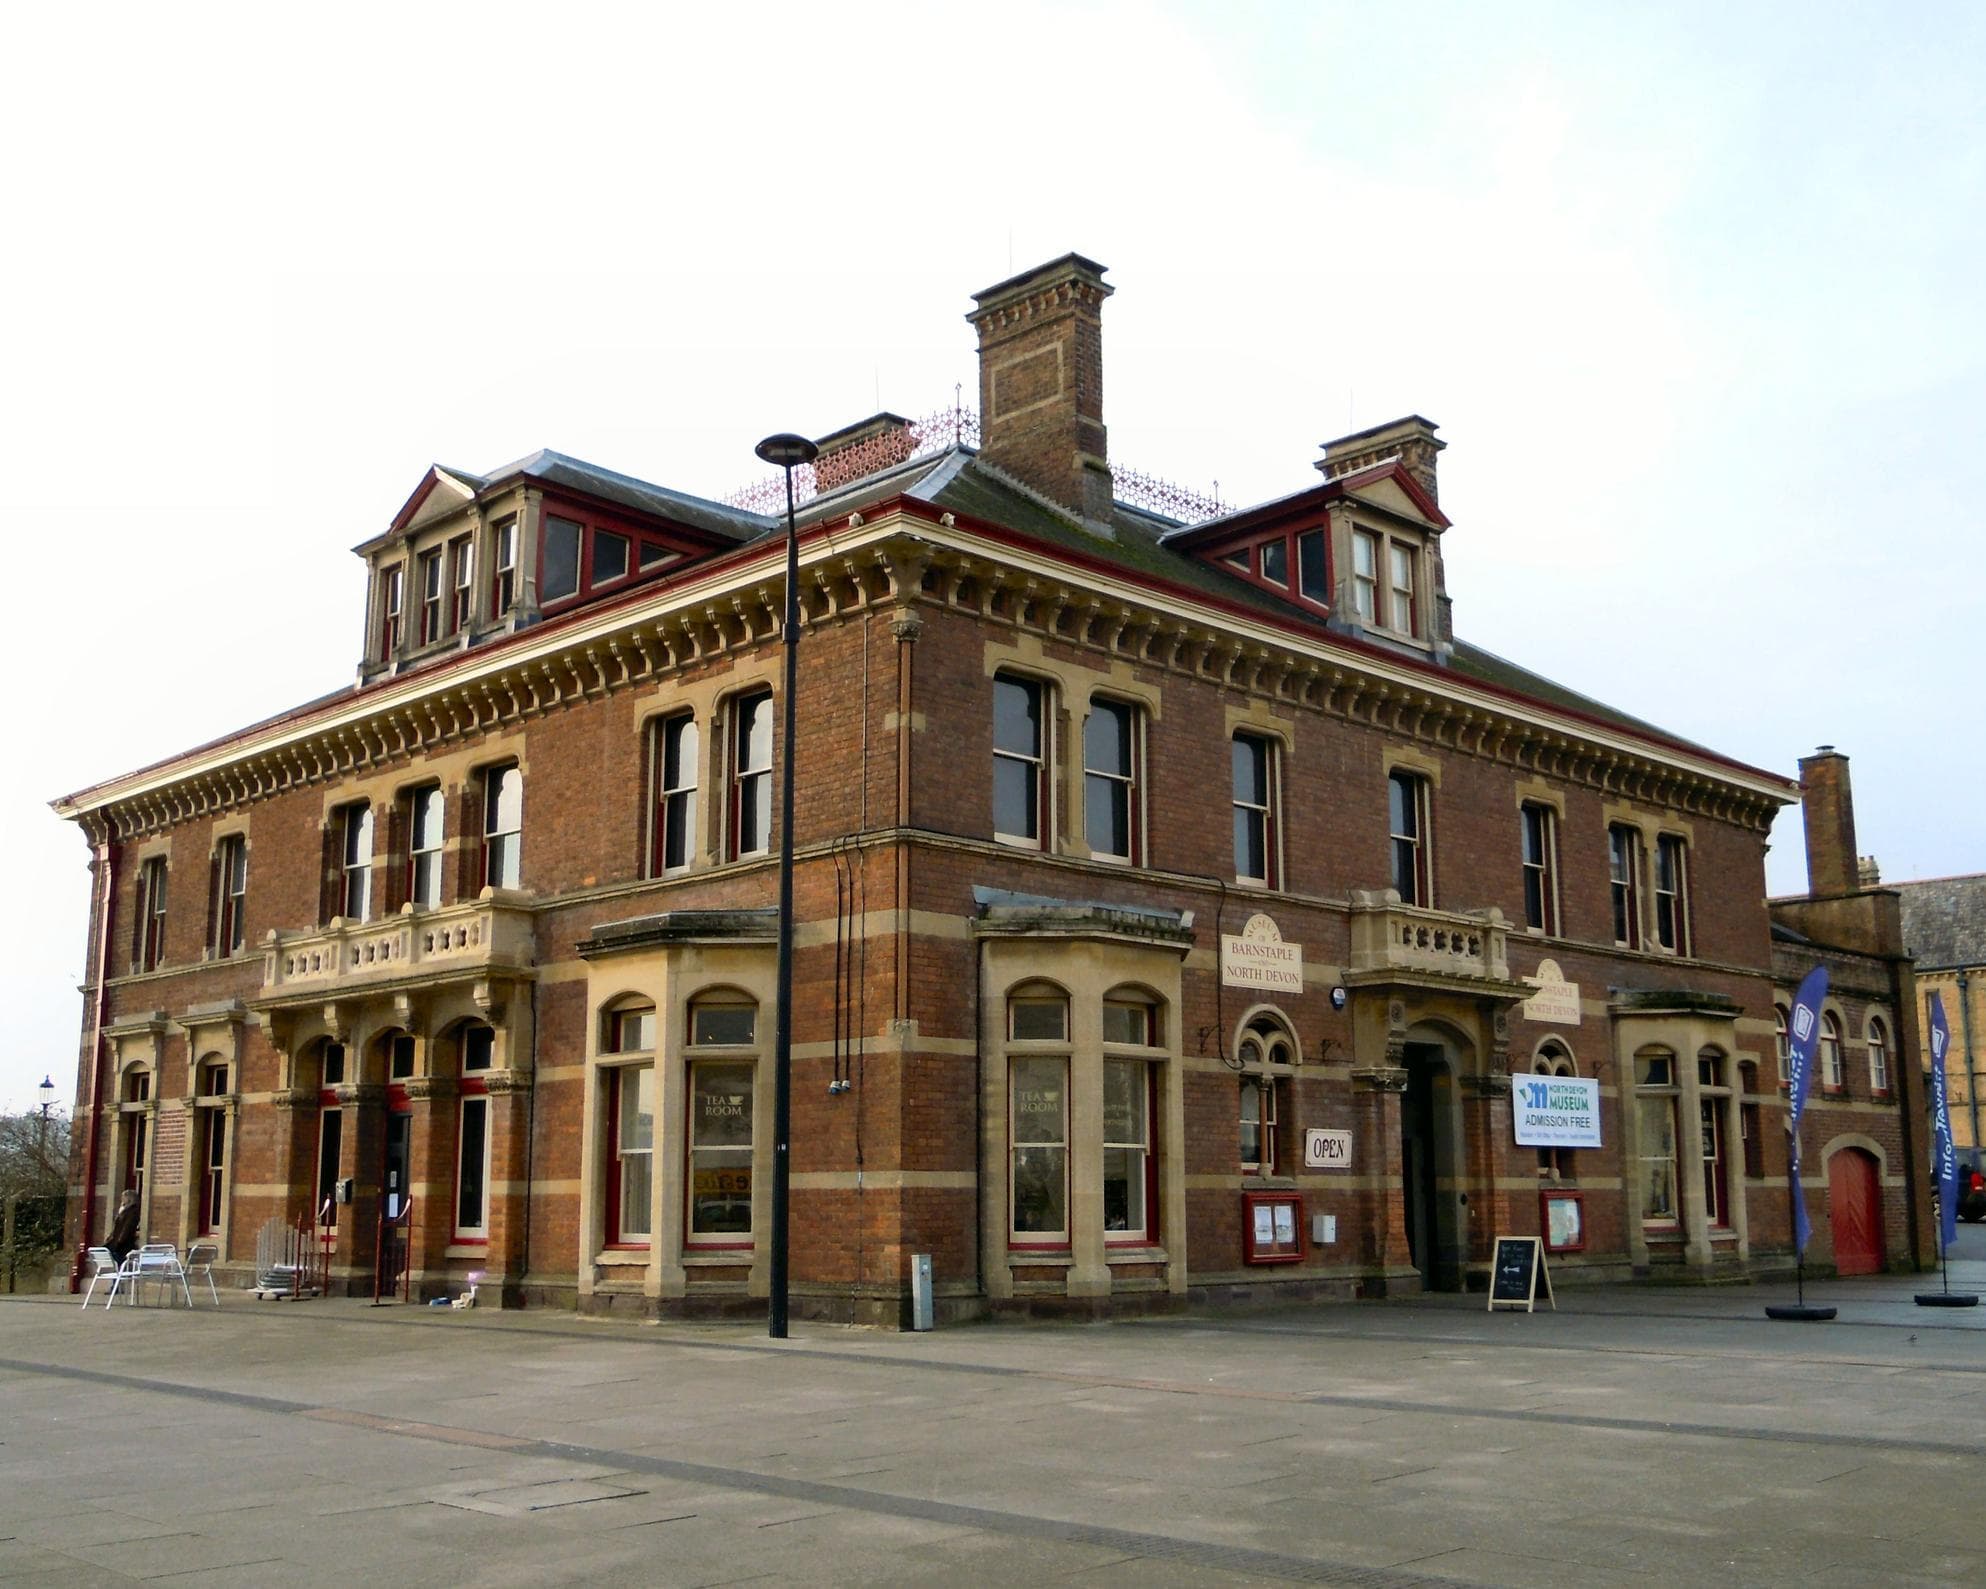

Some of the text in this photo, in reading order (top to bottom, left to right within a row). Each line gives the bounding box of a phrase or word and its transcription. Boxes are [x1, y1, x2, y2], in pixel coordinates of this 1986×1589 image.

[1247, 920, 1278, 942] MUSEUM
[1231, 942, 1294, 961] BARNSTAPLE
[1226, 966, 1299, 984] NORTH DEVON
[1021, 1091, 1041, 1101] TEA
[1549, 1084, 1588, 1095] NORTH DEVON
[706, 1095, 727, 1105] TEA
[1020, 1102, 1058, 1113] ROOM
[1549, 1096, 1589, 1111] MUSEUM
[705, 1106, 742, 1117] ROOM
[1525, 1114, 1591, 1129] ADMISSION FREE
[1313, 1138, 1345, 1158] OPEN
